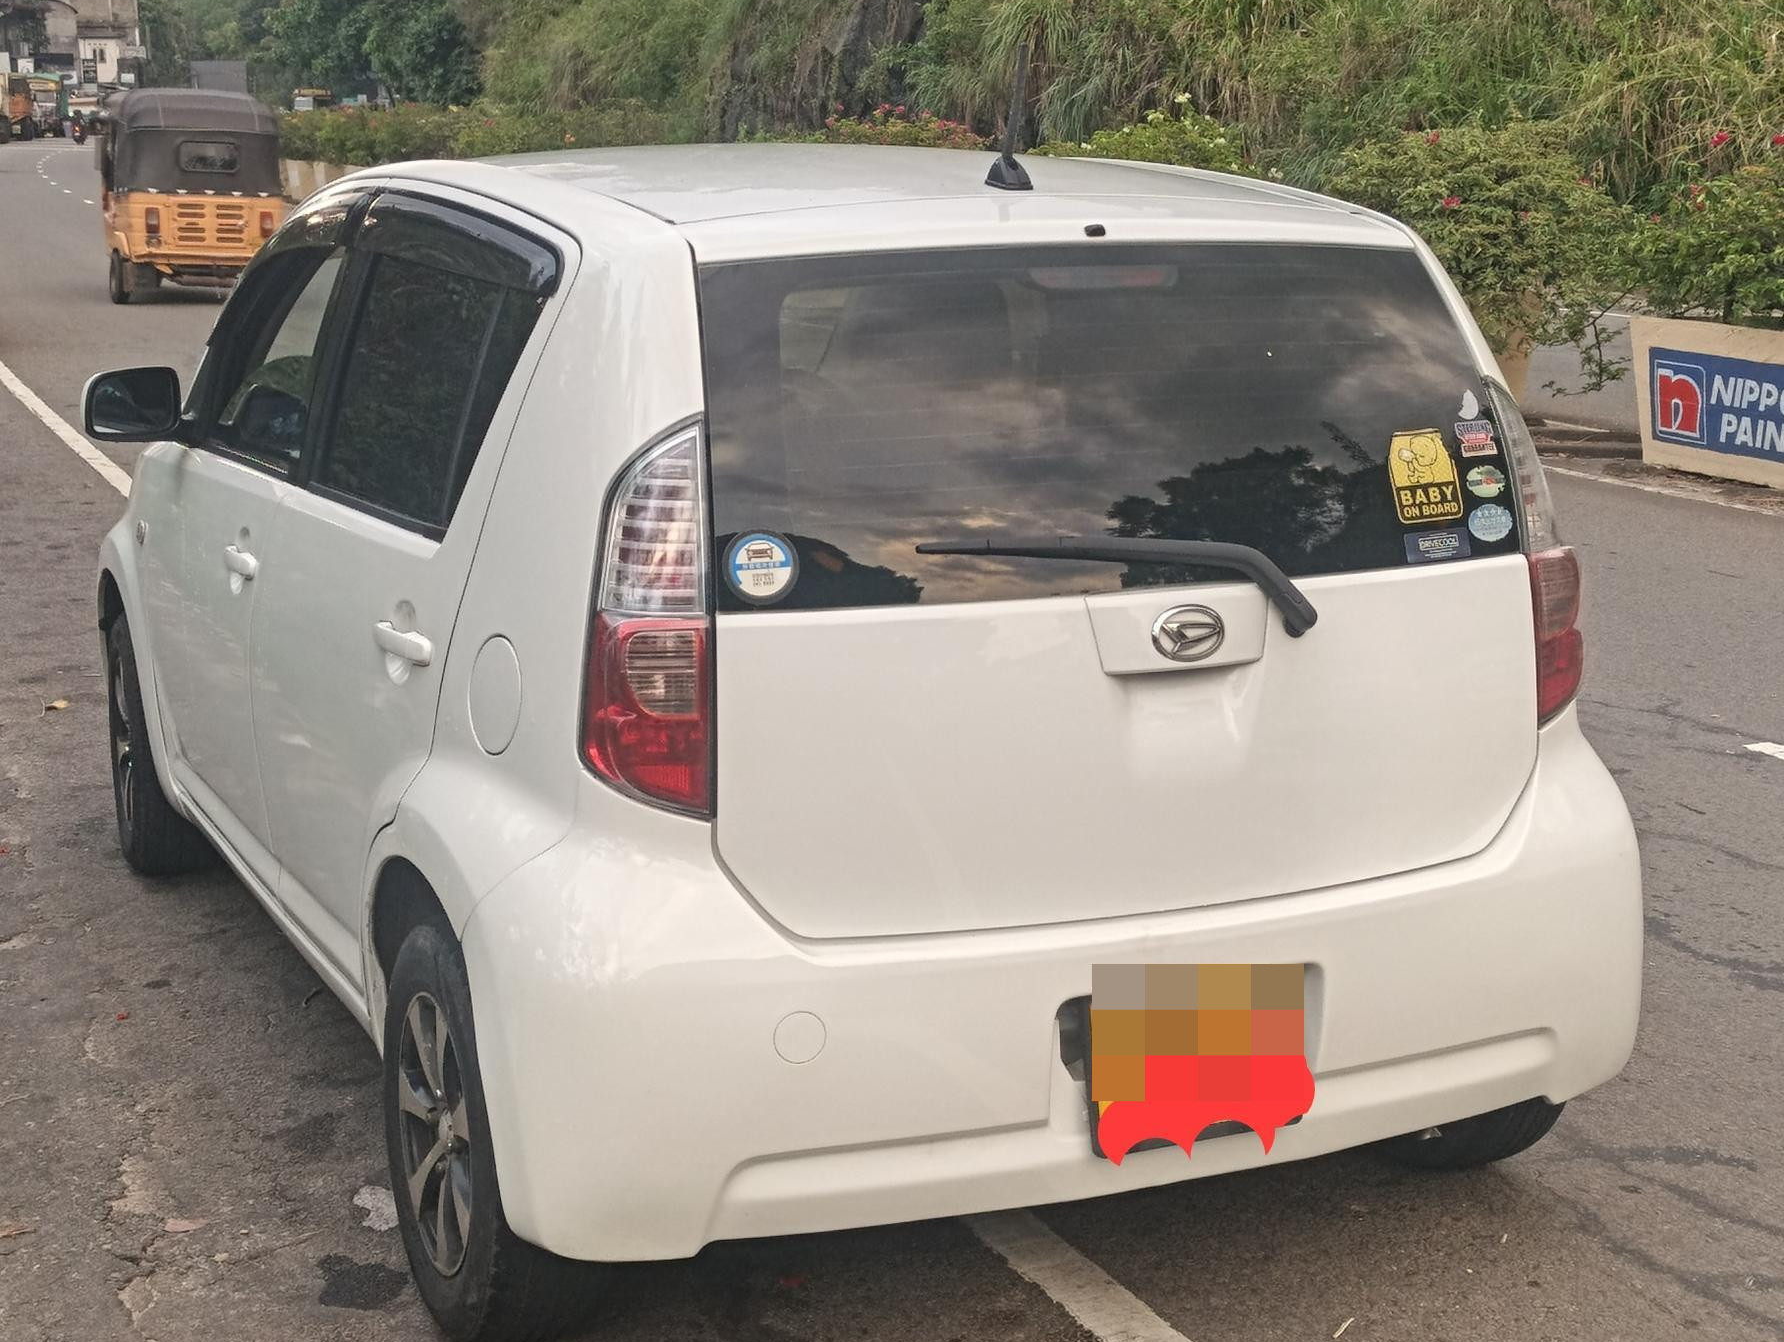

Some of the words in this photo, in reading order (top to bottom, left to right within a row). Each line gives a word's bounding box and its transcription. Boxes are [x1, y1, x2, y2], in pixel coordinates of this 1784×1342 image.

[1710, 374, 1784, 415] NIPP
[1400, 486, 1454, 505] BABY
[1404, 506, 1420, 518] ON
[1422, 502, 1459, 516] BOARD
